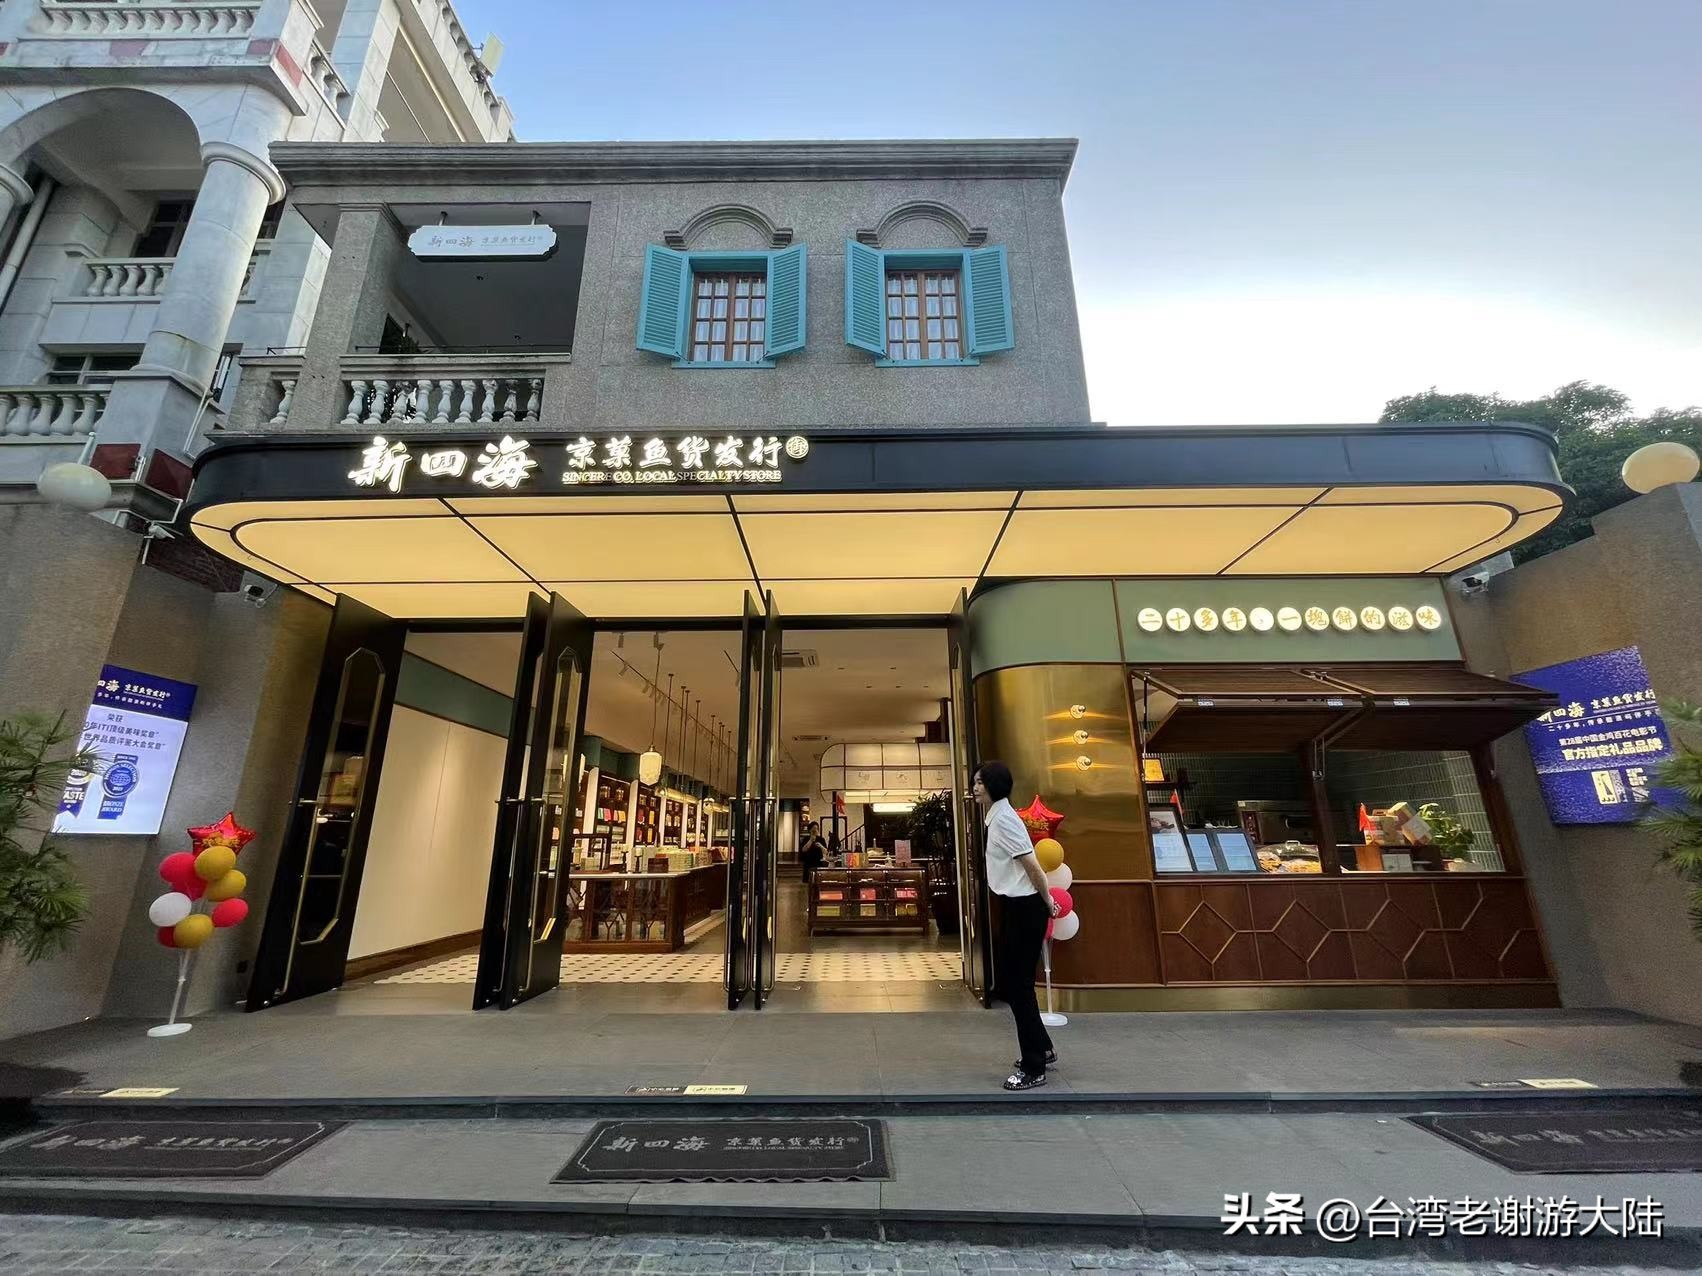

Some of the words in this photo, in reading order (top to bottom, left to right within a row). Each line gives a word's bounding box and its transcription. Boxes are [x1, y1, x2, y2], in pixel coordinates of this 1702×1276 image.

[348, 435, 538, 493] 新四海
[562, 471, 613, 485] SINCERE
[635, 471, 677, 483] LOCAL
[677, 470, 745, 483] SPECIALTY
[744, 470, 782, 482] STORE
[1138, 606, 1442, 632] 二十多年一塊餅的滋味
[1562, 738, 1664, 761] 官方指定礼品品牌
[602, 1136, 709, 1152] 新四海
